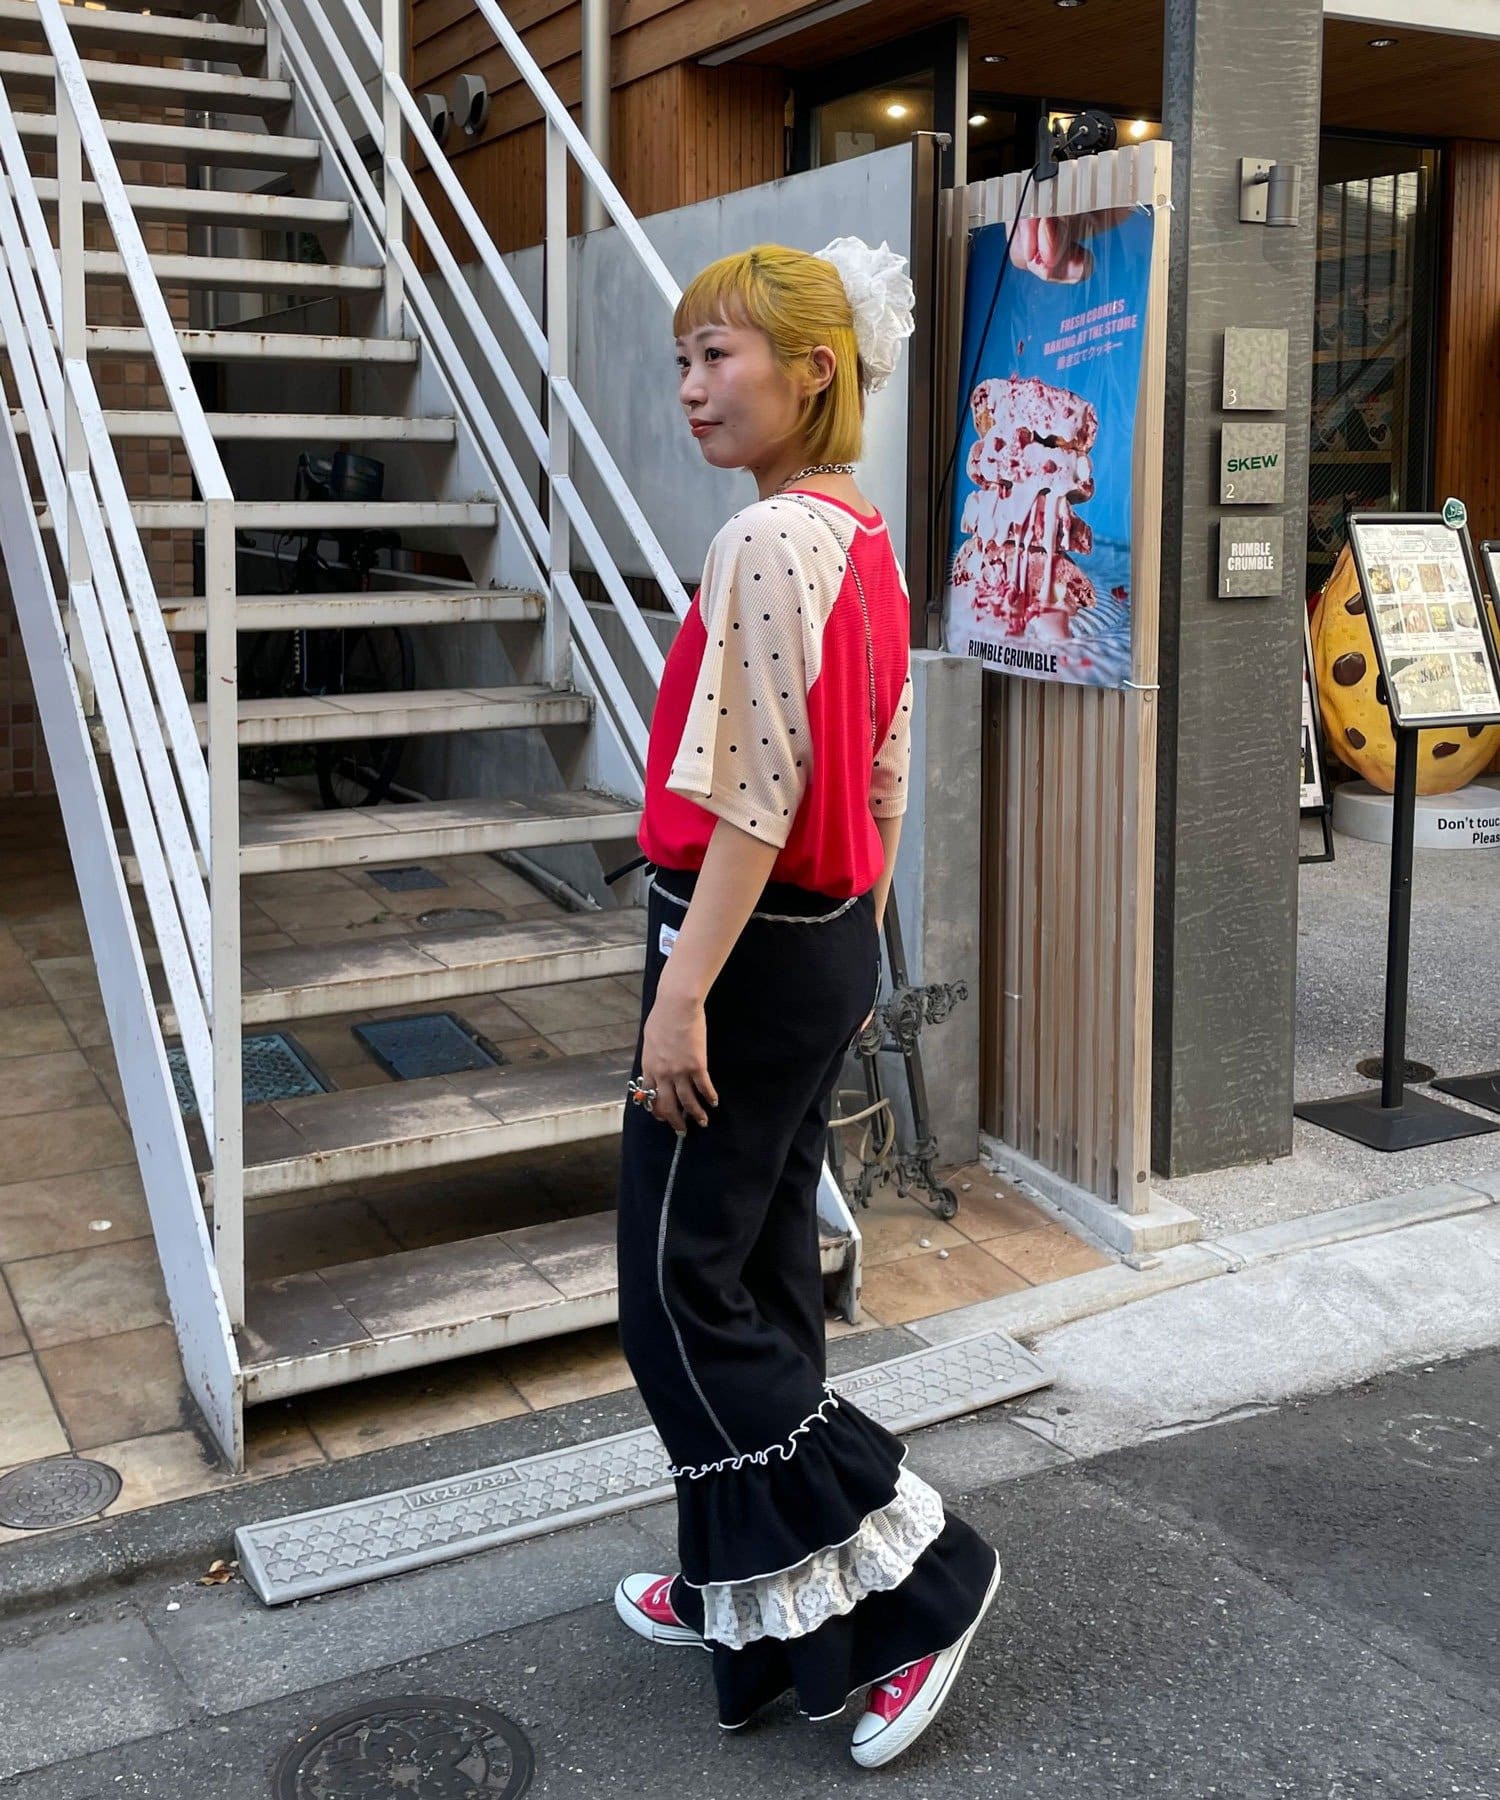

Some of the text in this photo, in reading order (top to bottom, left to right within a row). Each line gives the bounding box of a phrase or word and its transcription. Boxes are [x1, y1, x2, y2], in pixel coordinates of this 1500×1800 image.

[1060, 299, 1125, 334] FRESH COOKIES
[1044, 314, 1138, 356] BAKING AT THE STORE
[1228, 388, 1237, 405] 3
[1227, 454, 1278, 472] SKEW
[1225, 483, 1235, 499] 2
[1231, 542, 1271, 557] RUMBLE
[1228, 555, 1274, 571] CRUMBLE
[1225, 578, 1230, 593] 1
[968, 640, 1057, 673] RUMBLE CRUMBLE
[1438, 816, 1474, 830] Don't
